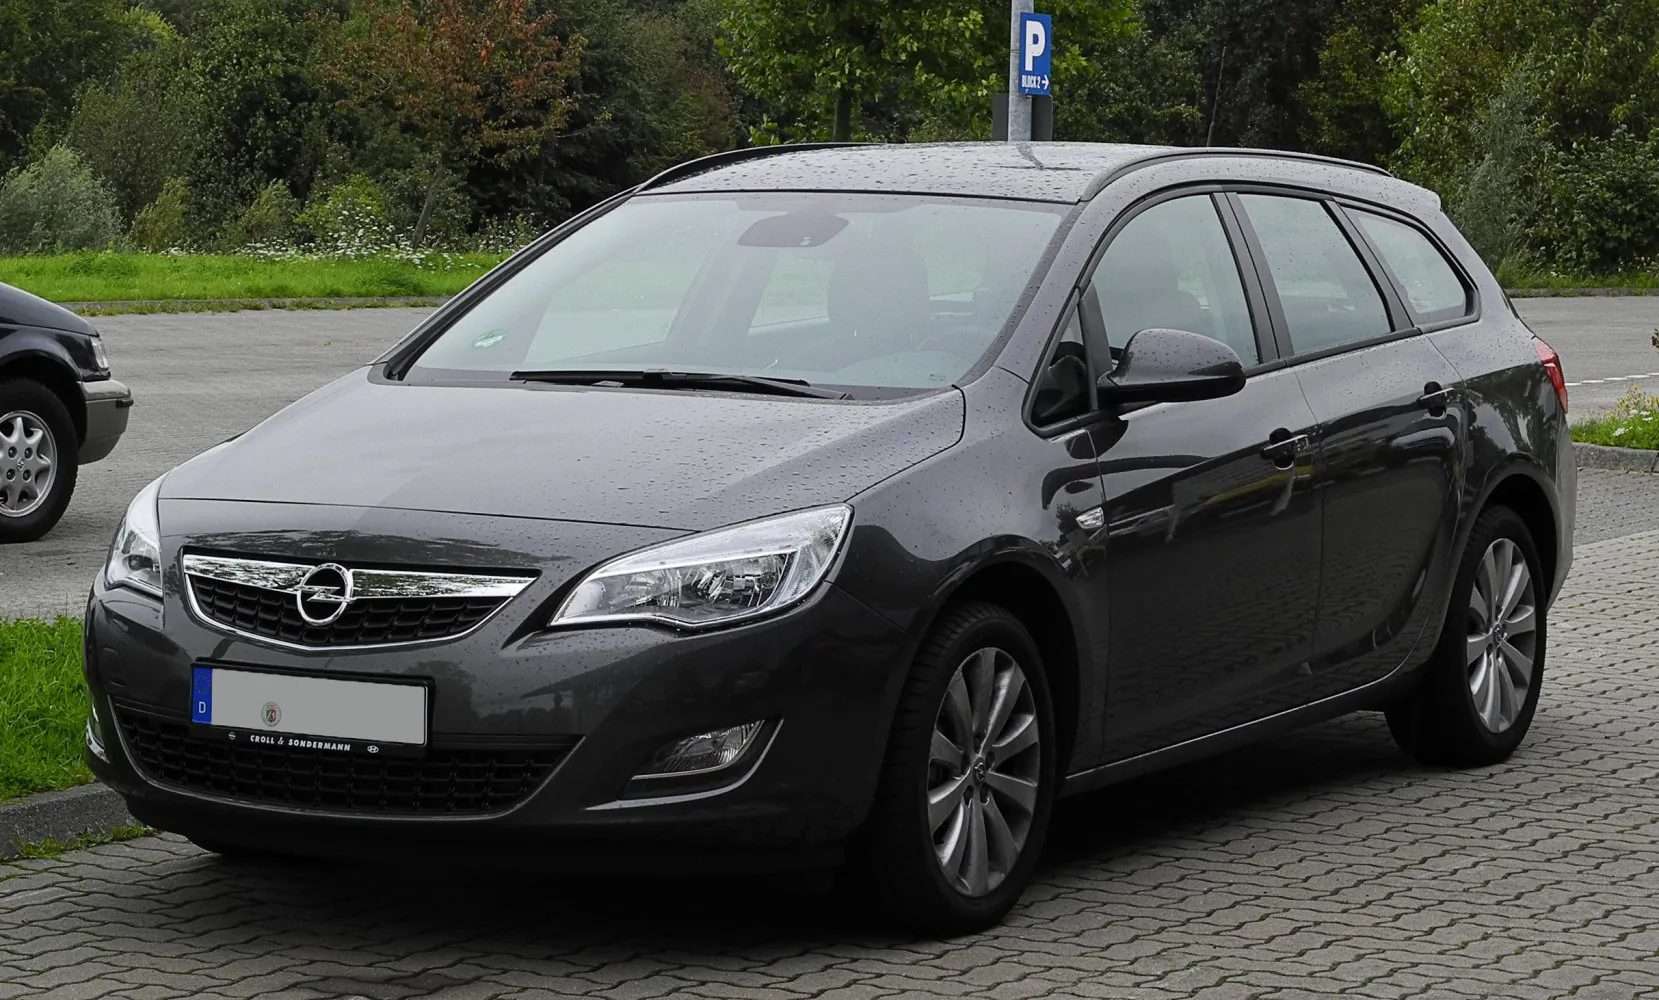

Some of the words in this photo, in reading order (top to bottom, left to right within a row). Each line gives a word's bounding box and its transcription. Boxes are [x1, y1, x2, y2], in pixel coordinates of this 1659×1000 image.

[1025, 20, 1045, 71] P
[1022, 75, 1037, 88] BLOCK
[1037, 76, 1041, 89] 2
[198, 701, 206, 713] D
[250, 734, 275, 745] CROLL
[277, 736, 285, 745] &
[288, 738, 351, 751] SONDERMANN
